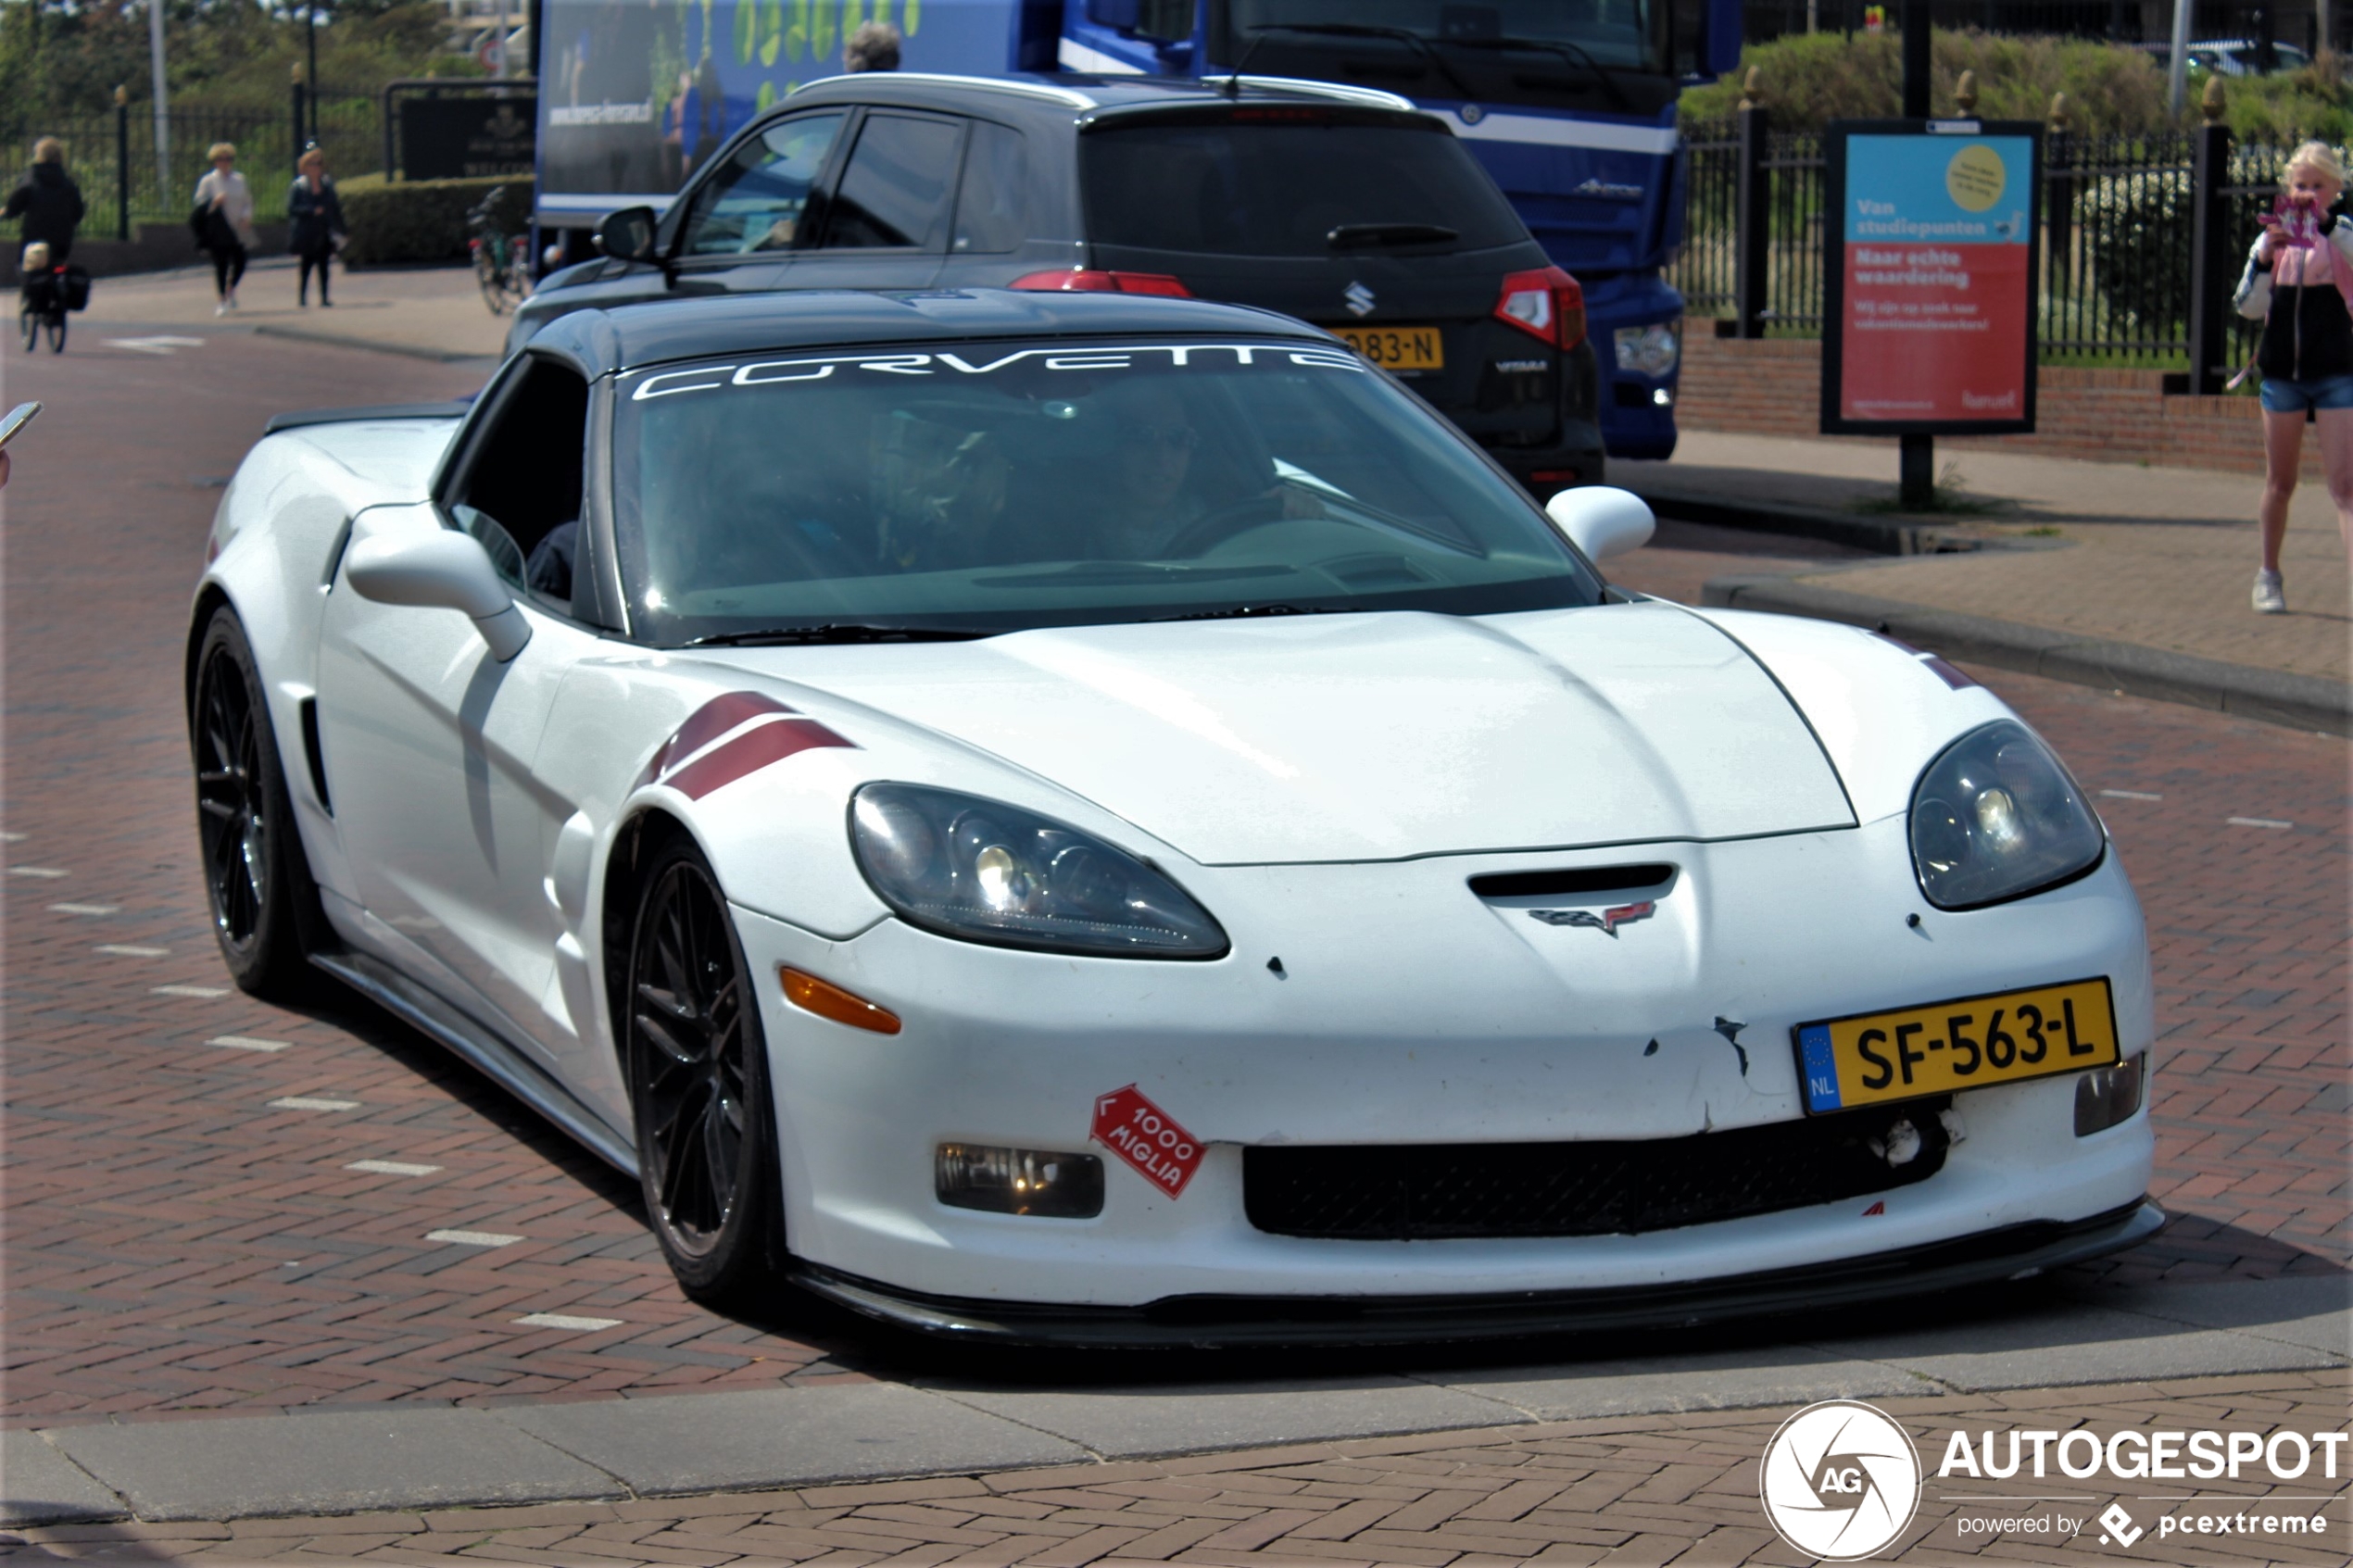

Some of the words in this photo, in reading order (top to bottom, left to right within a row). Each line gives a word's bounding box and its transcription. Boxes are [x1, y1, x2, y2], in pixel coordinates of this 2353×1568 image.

[1856, 199, 1895, 215] Van
[1856, 218, 1986, 238] studiepunten
[1856, 248, 1902, 265] Naar
[1907, 247, 1960, 266] echte
[1855, 267, 1969, 290] waardering
[632, 345, 1365, 400] CORVETTE
[1857, 998, 2095, 1089] SF-563-L
[1811, 1077, 1834, 1097] NL
[1133, 1108, 1193, 1160] 1000
[1108, 1124, 1182, 1186] MIGLIA
